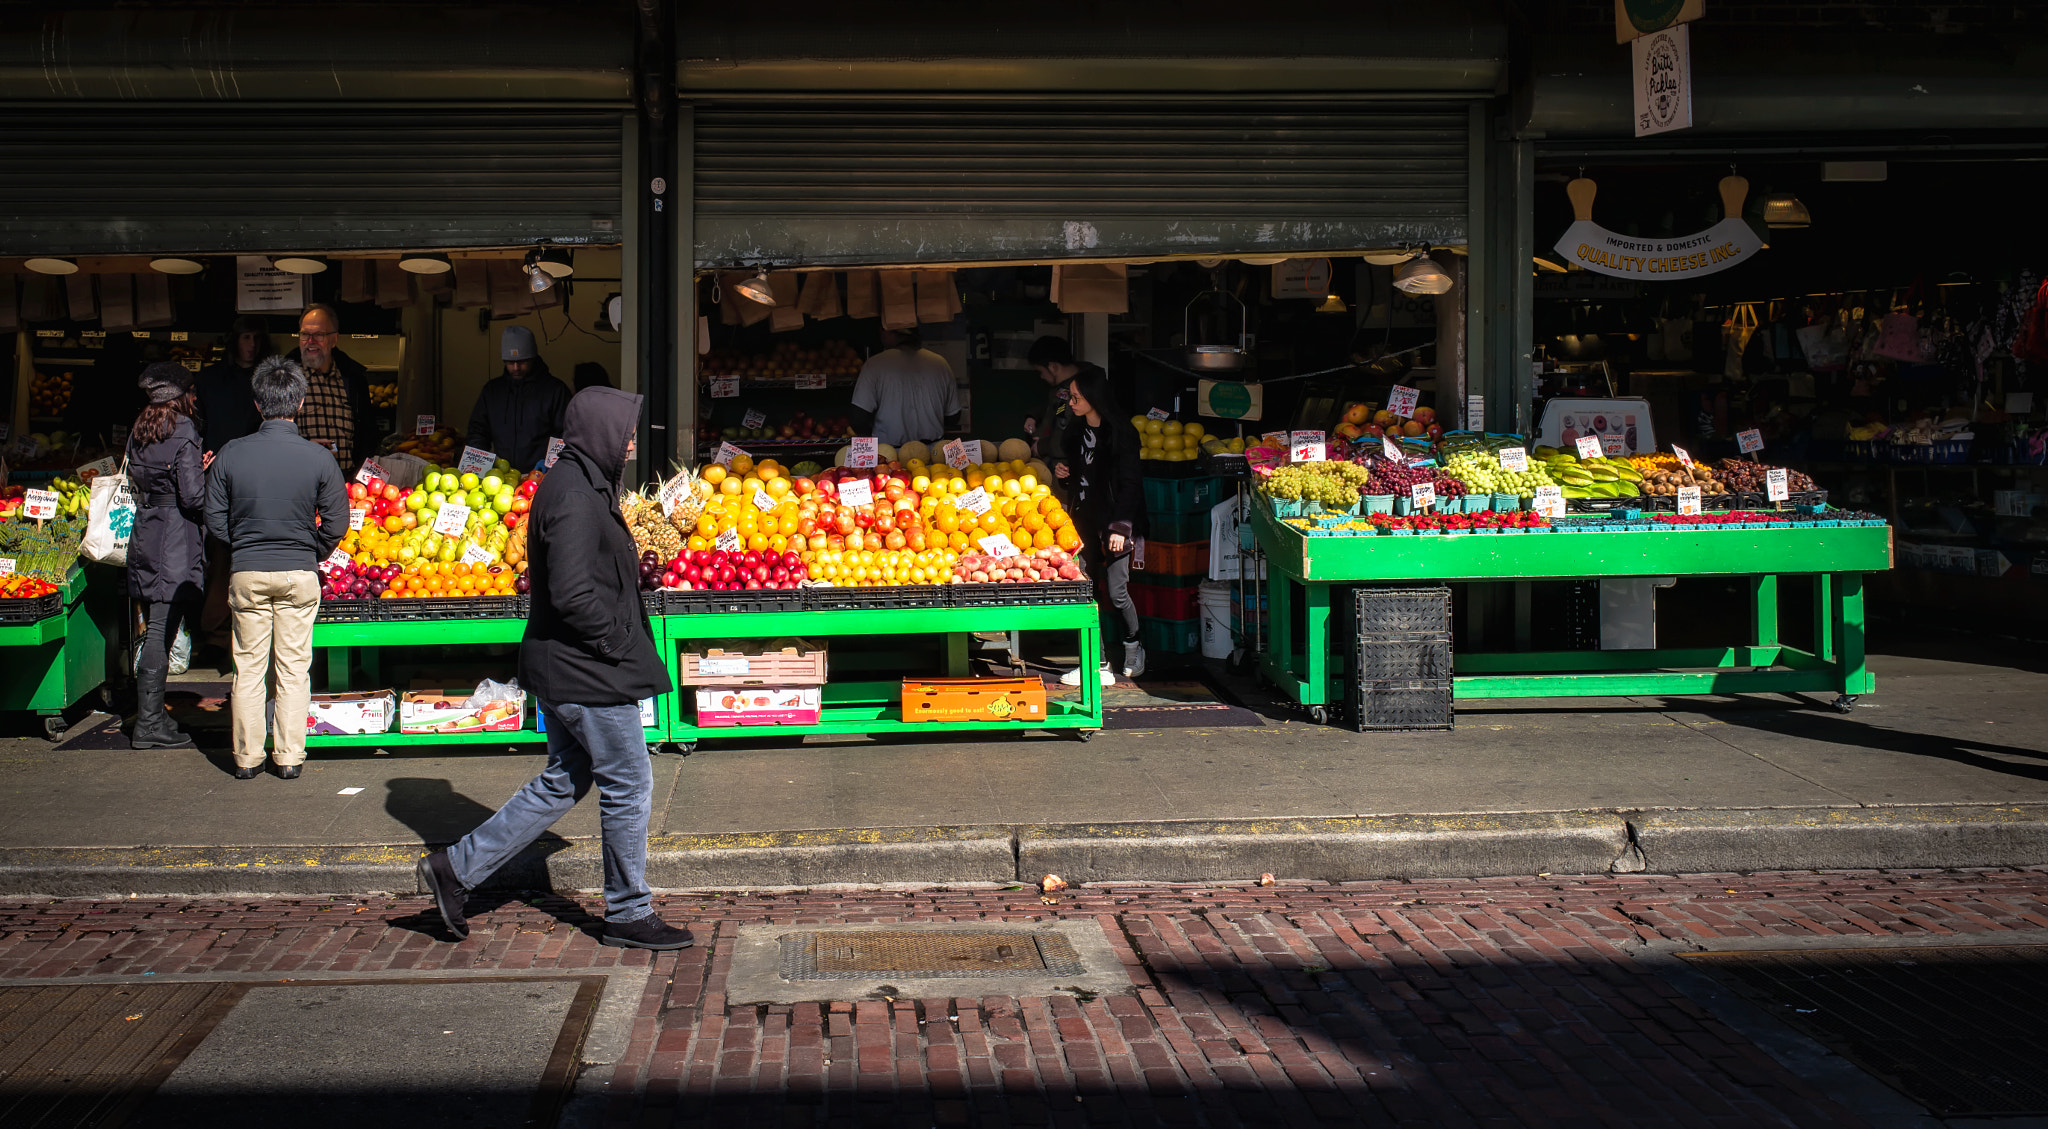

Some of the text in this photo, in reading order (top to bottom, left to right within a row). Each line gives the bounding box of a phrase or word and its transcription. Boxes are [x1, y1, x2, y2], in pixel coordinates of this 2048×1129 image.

[1650, 72, 1677, 96] Pickles
[1606, 234, 1712, 252] IMPORTED & DOMESTIC
[1576, 241, 1741, 273] QUALITY CHEESE INC.
[121, 485, 141, 494] FRA
[914, 707, 948, 715] Enormously
[949, 706, 964, 715] good
